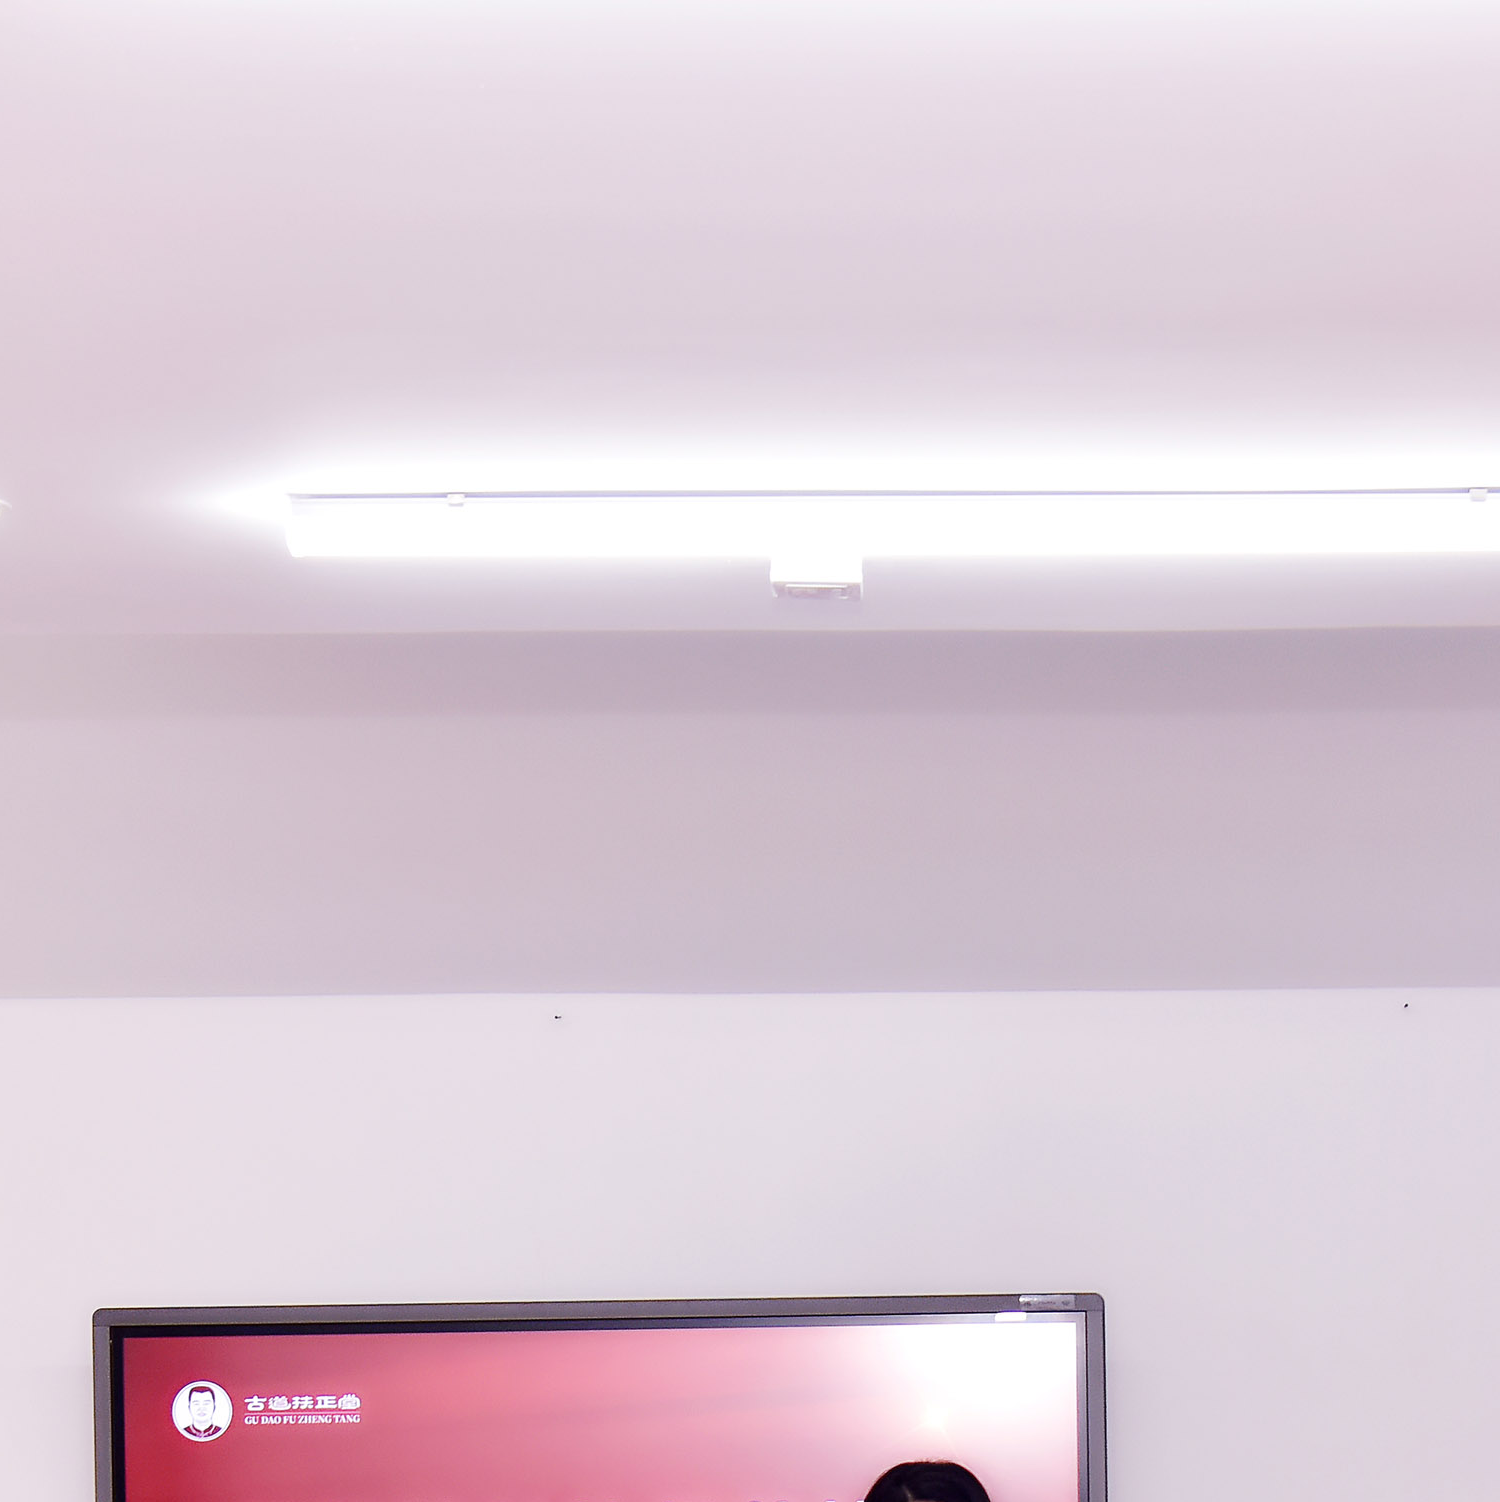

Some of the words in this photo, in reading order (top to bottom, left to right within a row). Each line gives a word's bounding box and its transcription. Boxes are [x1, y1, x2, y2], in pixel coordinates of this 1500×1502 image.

[244, 1415, 260, 1425] GU
[261, 1415, 282, 1425] DAO
[283, 1414, 297, 1424] FU
[298, 1414, 333, 1424] ZHENG
[333, 1414, 361, 1424] TANG
